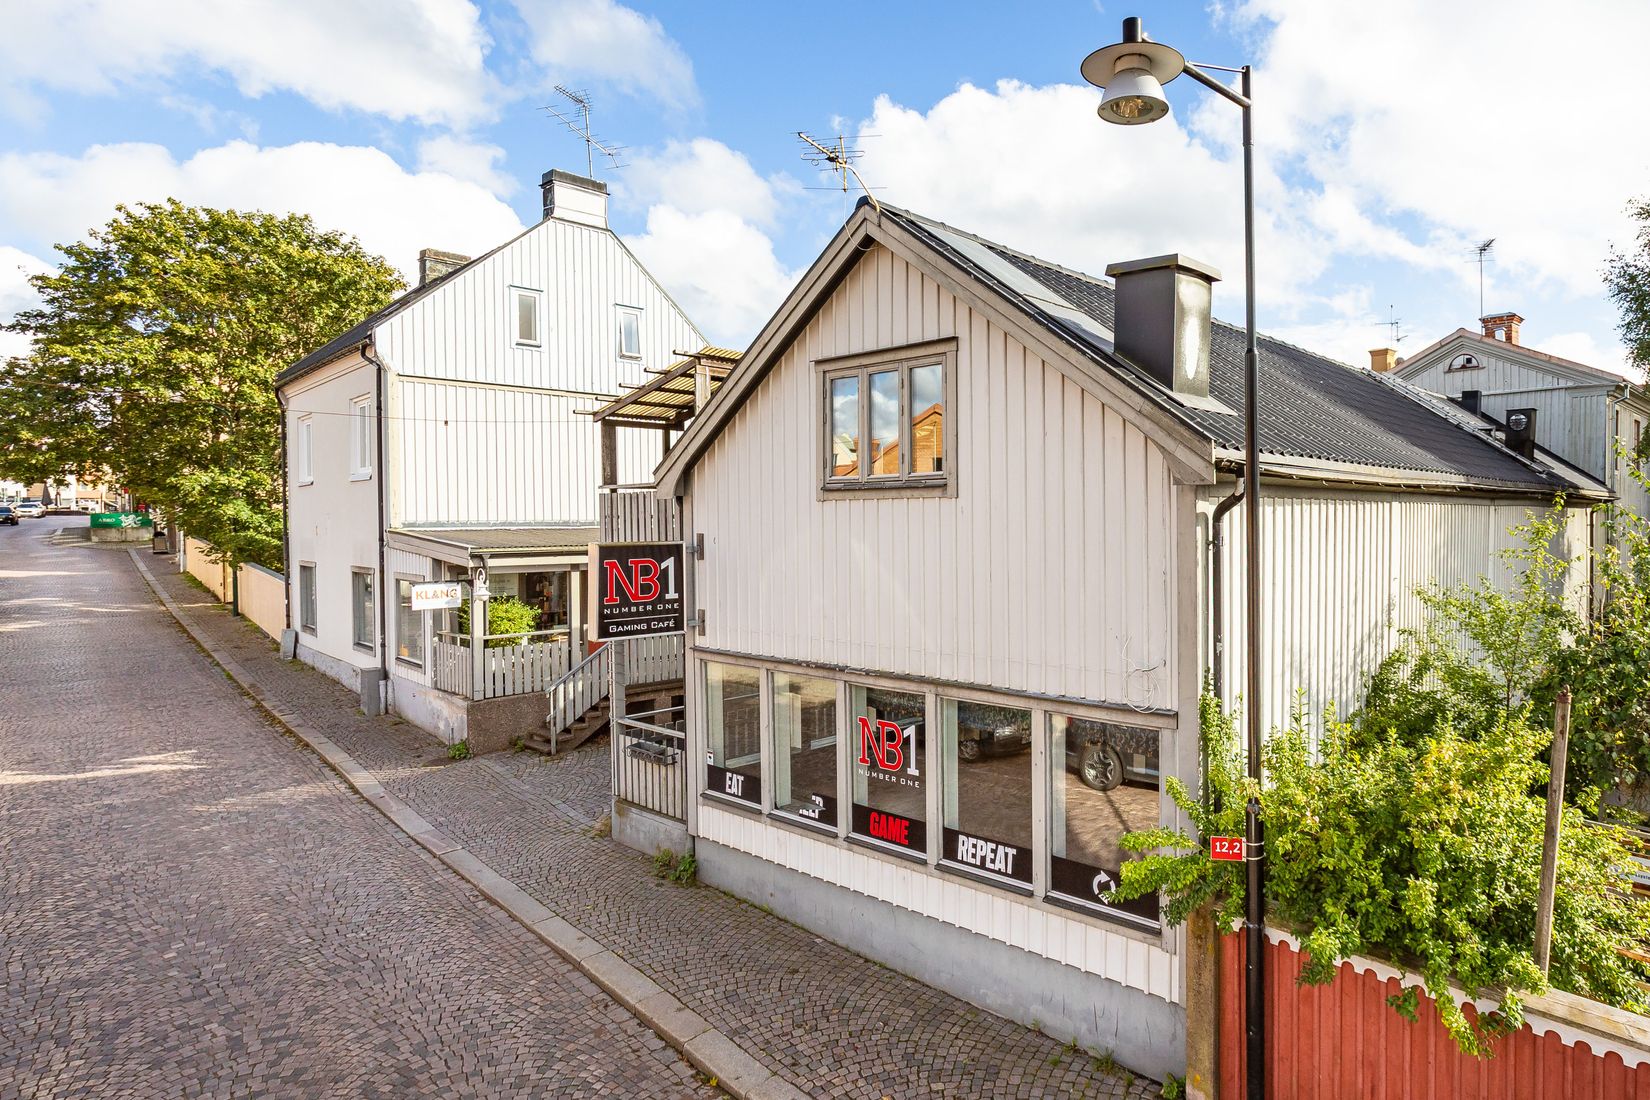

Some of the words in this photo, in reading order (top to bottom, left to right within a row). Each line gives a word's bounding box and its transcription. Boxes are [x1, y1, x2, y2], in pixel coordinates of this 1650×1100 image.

[603, 556, 680, 605] NB1
[603, 604, 653, 615] NUMBER
[657, 602, 680, 610] ONE
[857, 715, 920, 777] NB1
[725, 771, 745, 797] EAT
[858, 768, 897, 783] NUMBER
[900, 778, 920, 788] ONE
[869, 811, 910, 846] GAME
[957, 834, 1017, 875] REPEAT
[1215, 841, 1241, 855] 12,2
